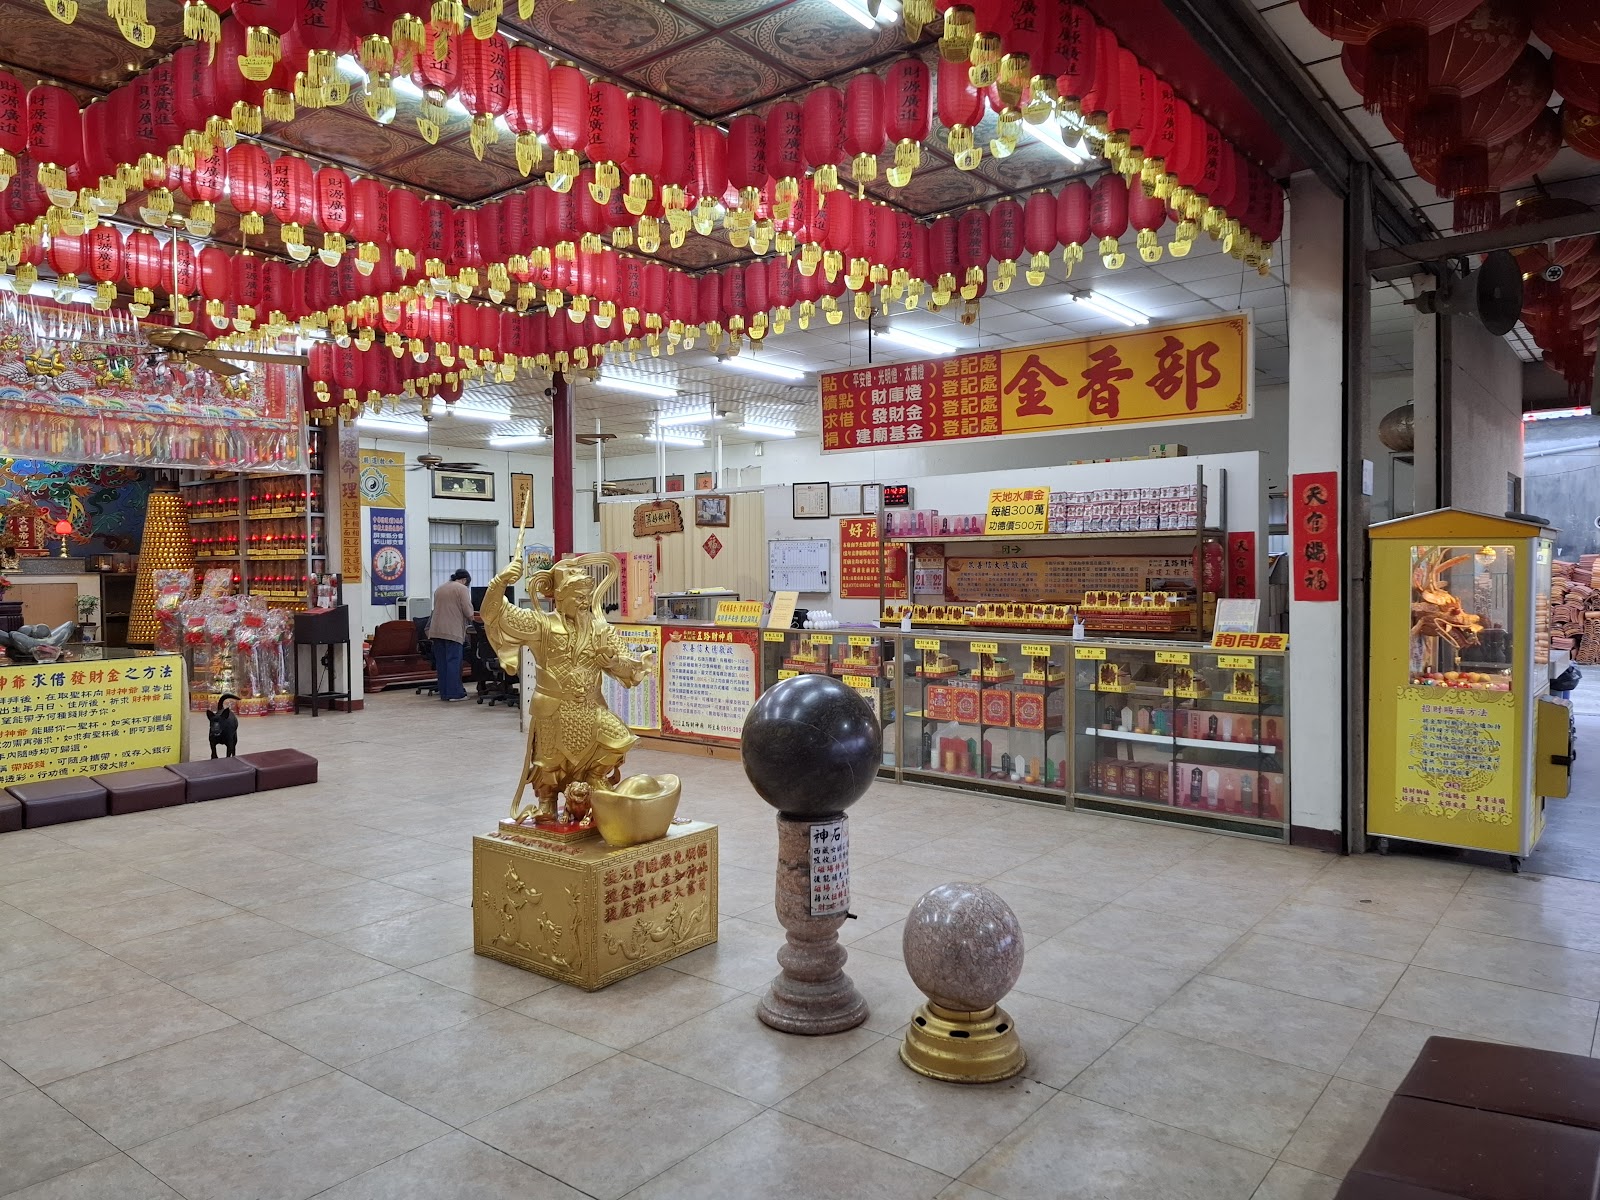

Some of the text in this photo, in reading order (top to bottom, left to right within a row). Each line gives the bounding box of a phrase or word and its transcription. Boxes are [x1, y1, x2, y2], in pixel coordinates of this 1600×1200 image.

[901, 66, 921, 122] 財源廣進
[29, 95, 50, 148] 財源廣進
[274, 165, 290, 211] 財源廣進
[327, 177, 346, 222] 財源廣進
[427, 210, 445, 251] 財源廣進
[453, 218, 468, 259] 財源廣進
[96, 233, 113, 272] 財源廣進
[627, 263, 639, 298] 財源廣進
[1003, 335, 1221, 419] 金香部
[342, 430, 358, 499] 種命理
[991, 489, 1045, 503] 天地水庫金
[991, 504, 1045, 517] 每組300萬
[1304, 486, 1328, 591] 天官賜福
[915, 574, 925, 586] 21
[932, 574, 943, 586] 22
[1214, 633, 1284, 650] 詢問處
[1422, 704, 1488, 717] 招財賜福方法
[813, 827, 841, 844] 神石
